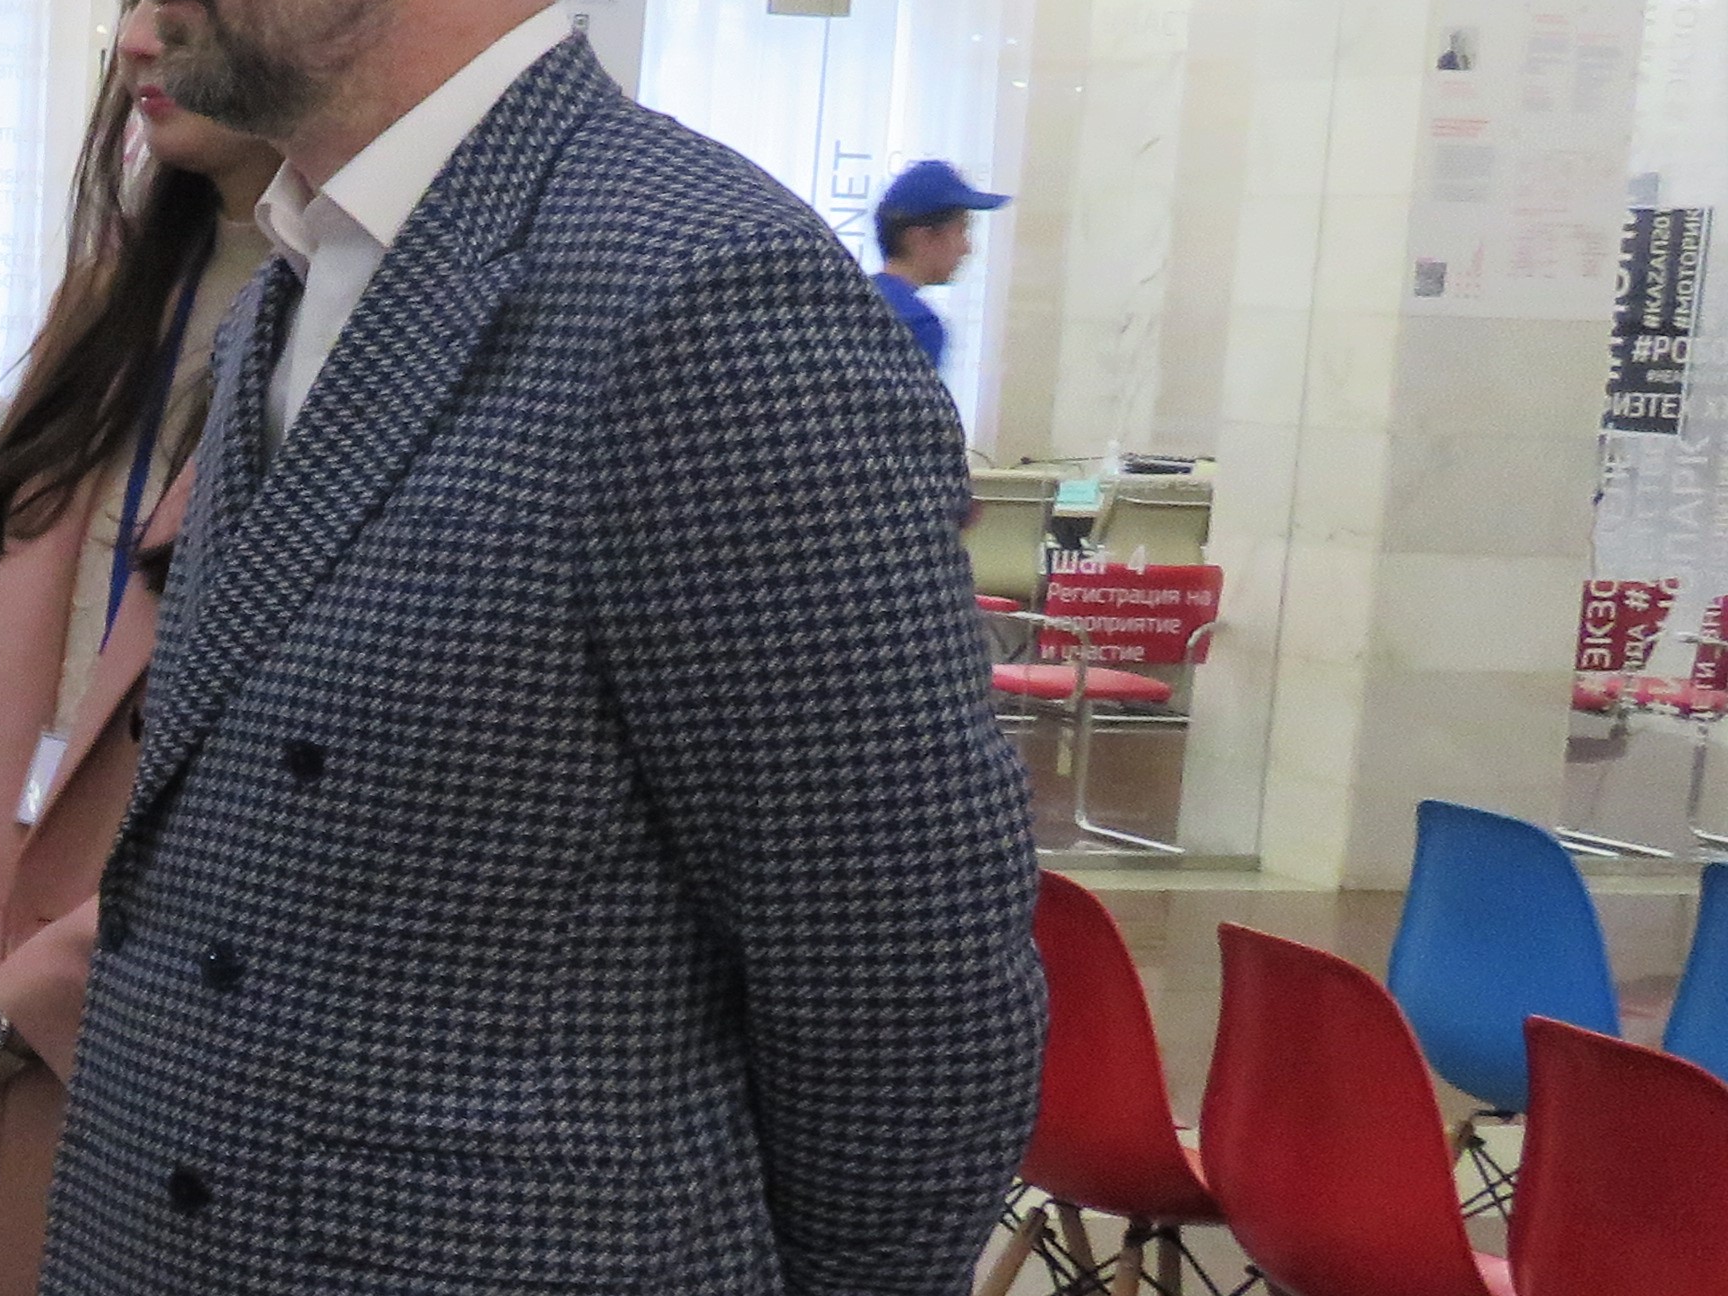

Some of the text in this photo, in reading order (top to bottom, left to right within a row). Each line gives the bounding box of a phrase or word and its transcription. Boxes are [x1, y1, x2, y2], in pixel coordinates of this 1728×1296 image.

[1051, 546, 1147, 574] Шаг 4
[1046, 582, 1212, 608] Регистрация на
[1046, 615, 1182, 635] ероприятие
